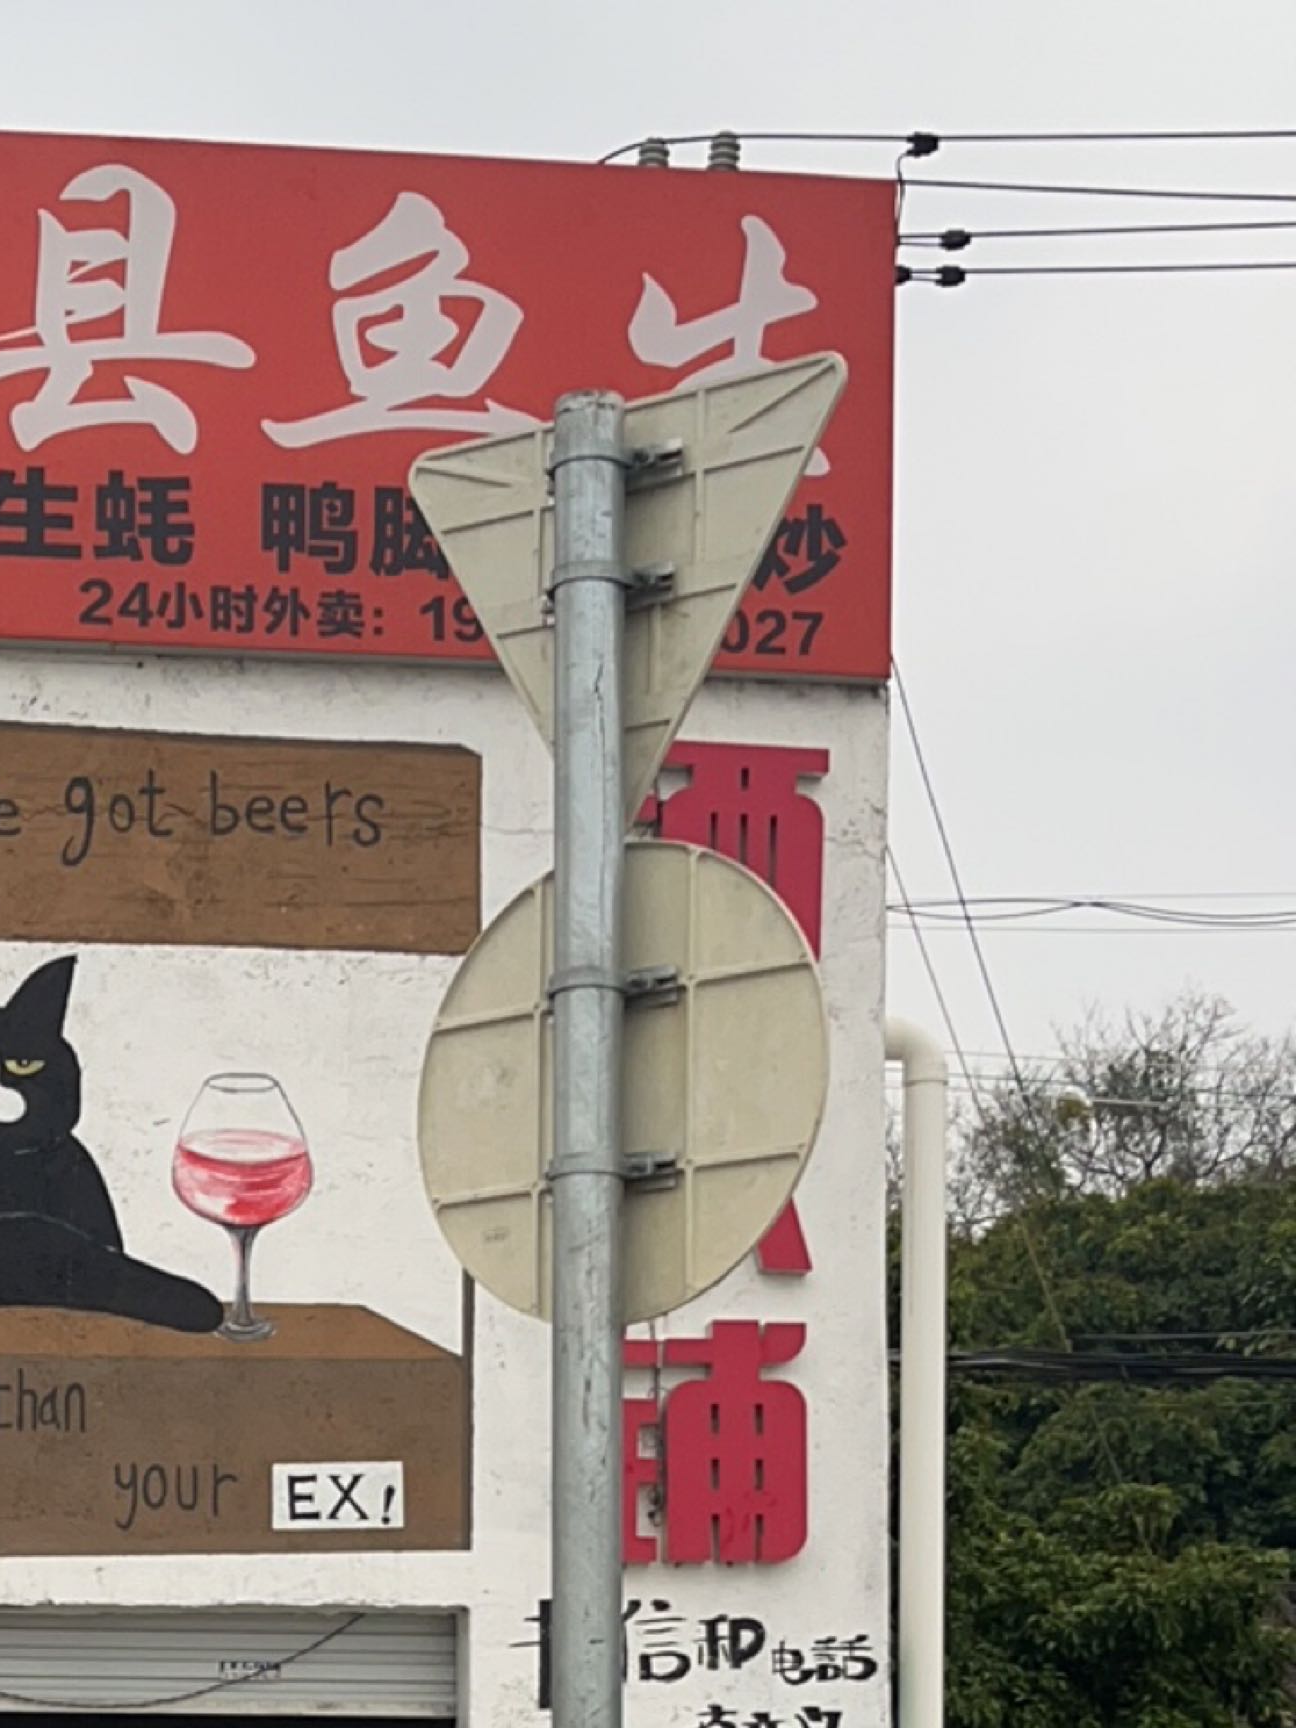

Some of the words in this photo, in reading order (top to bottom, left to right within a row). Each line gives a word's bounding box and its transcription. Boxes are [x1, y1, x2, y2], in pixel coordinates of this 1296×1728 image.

[61, 768, 174, 867] got
[210, 769, 384, 849] beers
[114, 1462, 239, 1530] your
[287, 1473, 398, 1528] EX!
